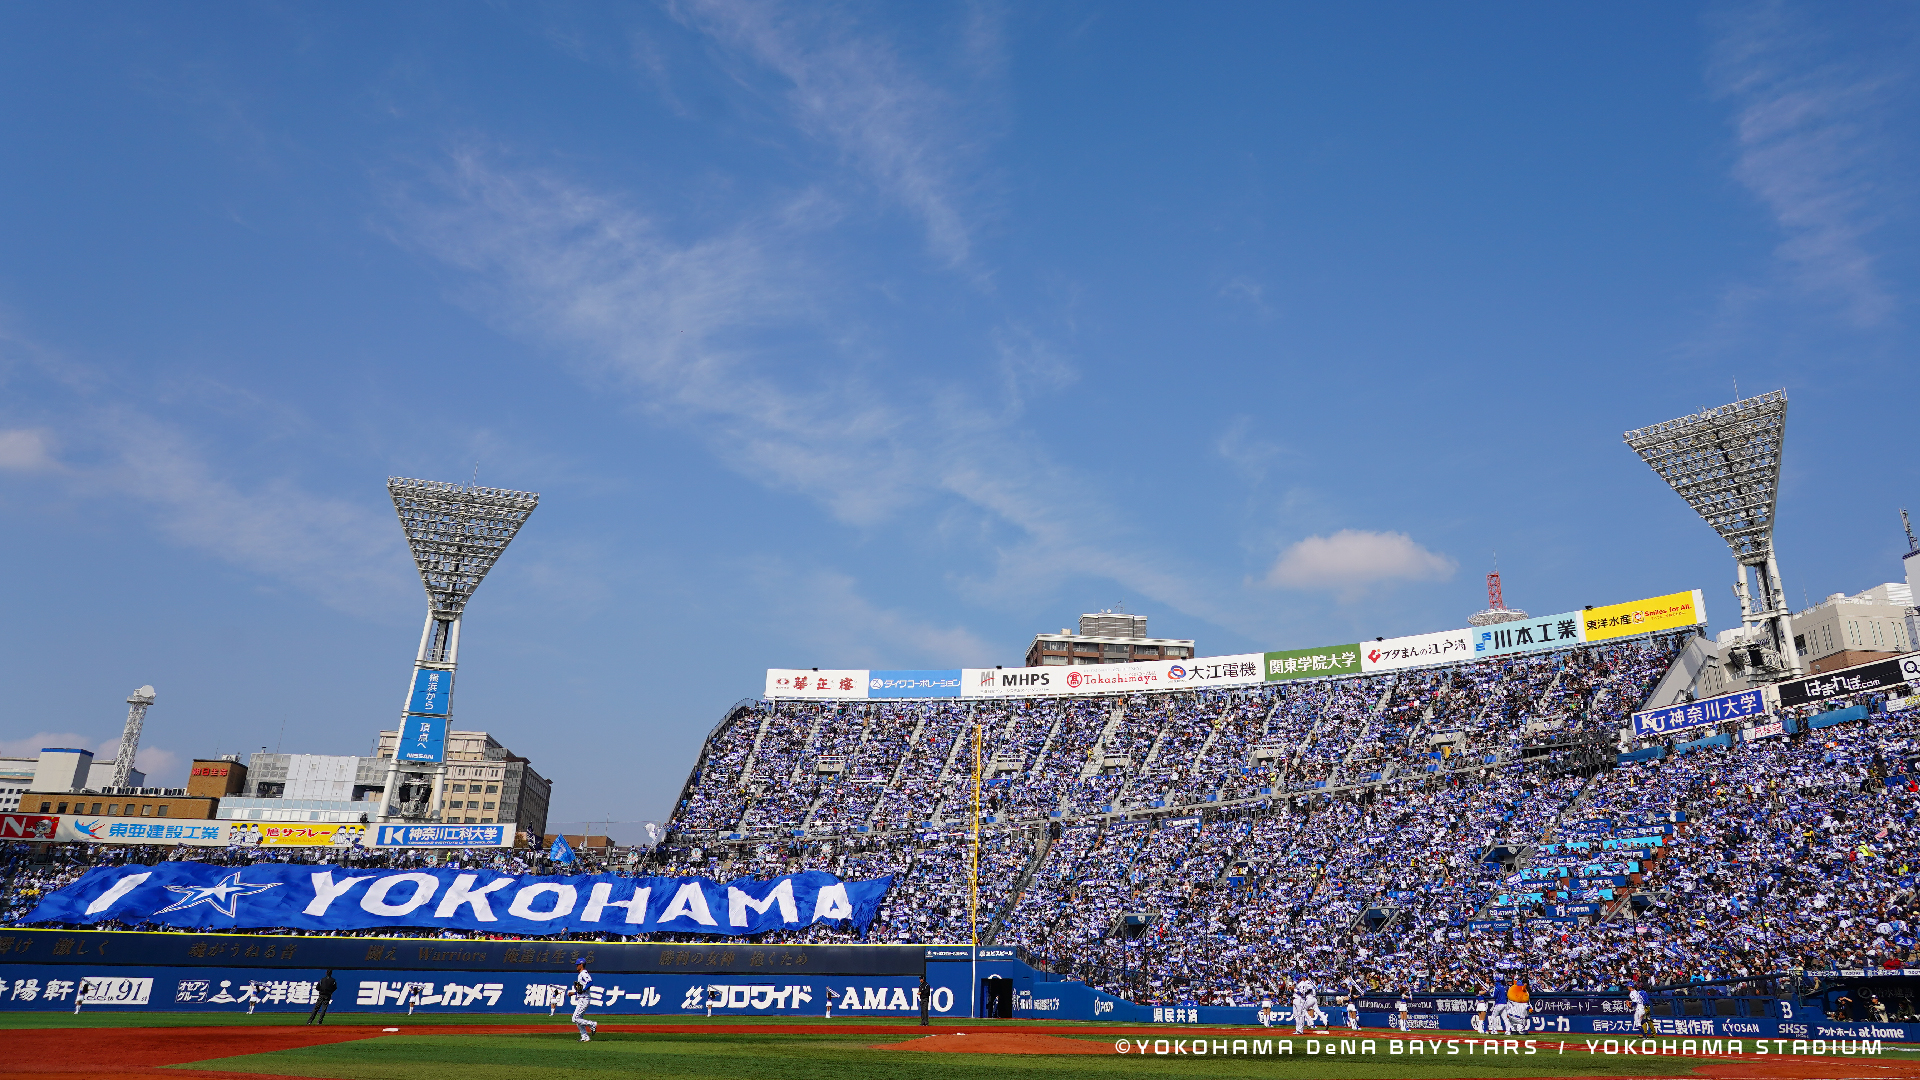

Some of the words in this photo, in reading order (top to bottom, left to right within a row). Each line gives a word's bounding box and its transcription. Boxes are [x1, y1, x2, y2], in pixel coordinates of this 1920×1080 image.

[1586, 614, 1632, 631] 東洋水産
[1494, 619, 1577, 650] 川本工業
[1382, 639, 1467, 661] ブタまんの江戸清
[1188, 661, 1257, 680] 大江電機
[1269, 651, 1357, 675] 関東学院大学
[883, 678, 961, 689] ダイワコーポレーション
[1002, 673, 1050, 687] MHPS
[1084, 673, 1158, 686] Takashimaya
[425, 673, 440, 711] 横浜から
[1669, 693, 1758, 727] 神奈川大学
[417, 722, 431, 749] 頂点へ
[406, 752, 434, 760] NISSAN
[108, 822, 220, 840] 東亜建設工業
[265, 827, 331, 838] 鳩サブレー
[408, 827, 498, 841] 神奈川工科大学
[84, 872, 152, 915] I
[301, 870, 853, 927] YOKOHAMA
[52, 937, 110, 956] 激しく
[365, 944, 397, 961] 闘え
[418, 946, 487, 962] Warriors
[658, 949, 736, 967] 勝利の女神
[749, 950, 809, 967] 抱くため
[178, 981, 210, 991] オセアン
[176, 991, 208, 1002] グループ
[707, 985, 812, 1010] コロワイド
[1545, 1000, 1599, 1012] 八千代ポートリー
[1781, 1001, 1793, 1020] B
[1153, 1008, 1198, 1023] 県民共済
[1722, 1021, 1760, 1036] KYOSAN
[1778, 1023, 1808, 1034] SKSS
[1816, 1027, 1857, 1037] アットホーム
[1871, 1025, 1905, 1039] home
